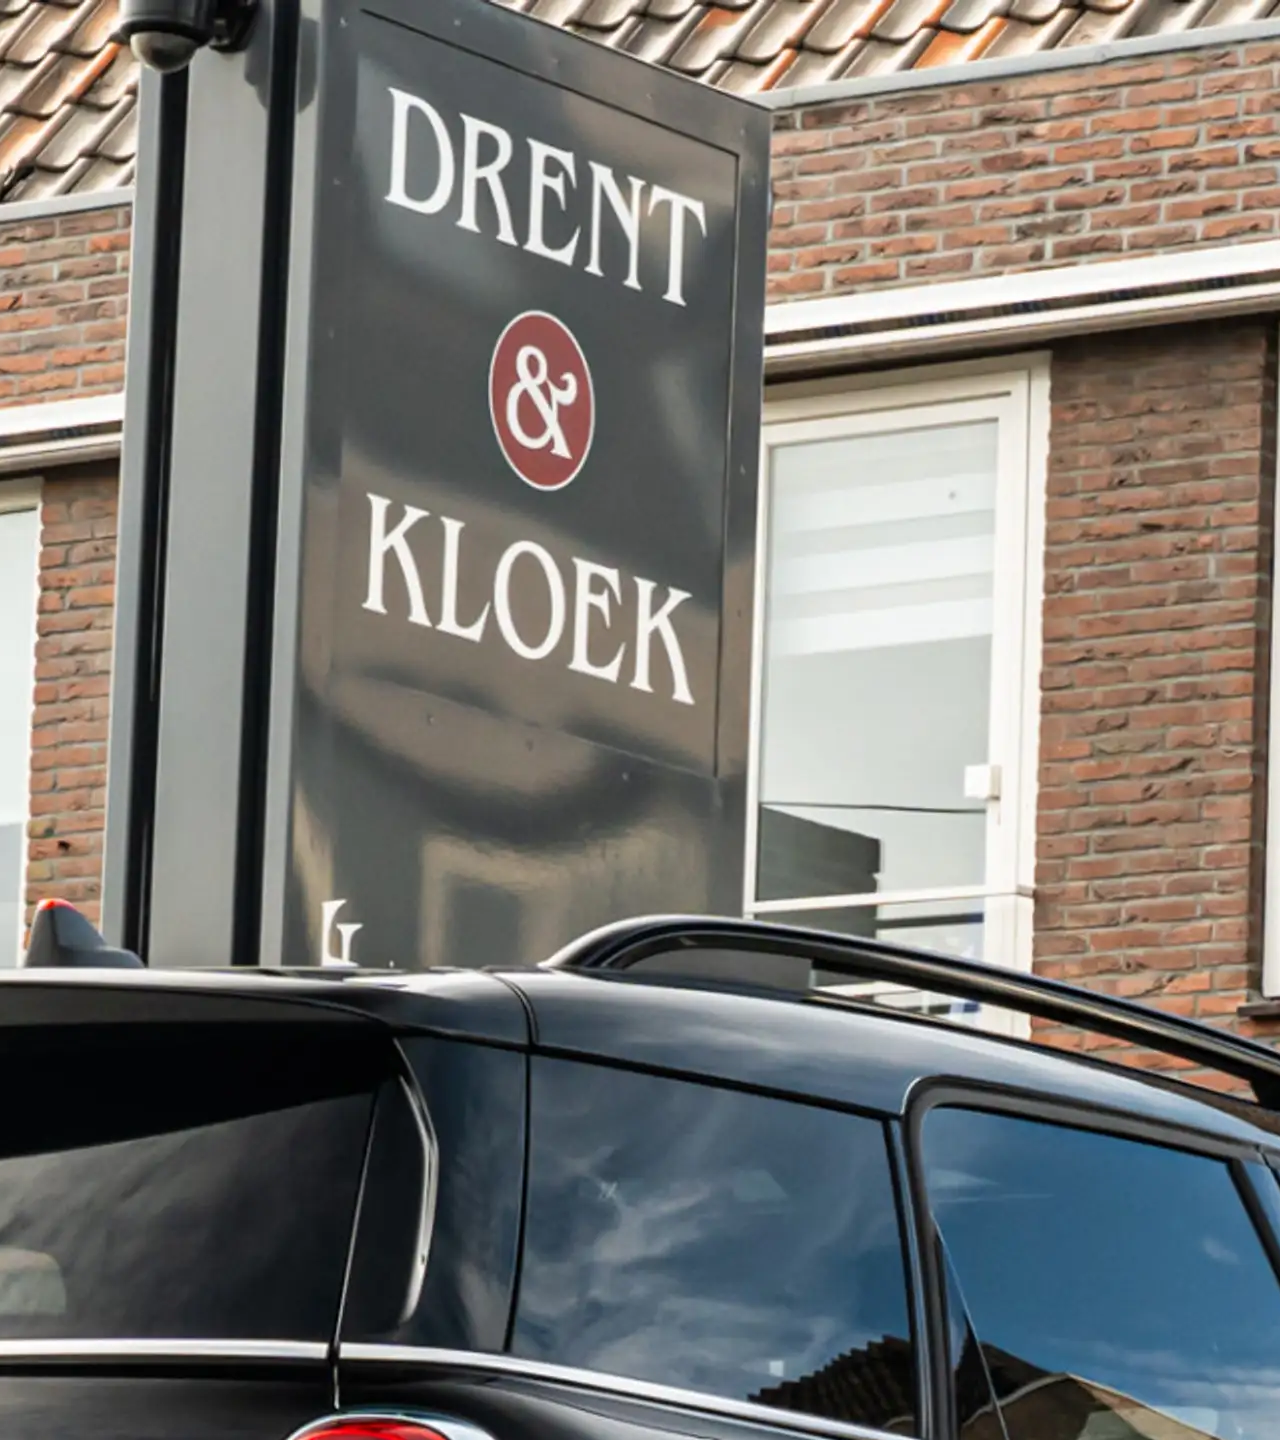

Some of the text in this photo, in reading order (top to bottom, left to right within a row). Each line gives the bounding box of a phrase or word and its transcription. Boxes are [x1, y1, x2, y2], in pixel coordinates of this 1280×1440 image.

[384, 87, 707, 306] DRENT
[505, 344, 577, 459] &
[361, 491, 696, 706] KLOEK
